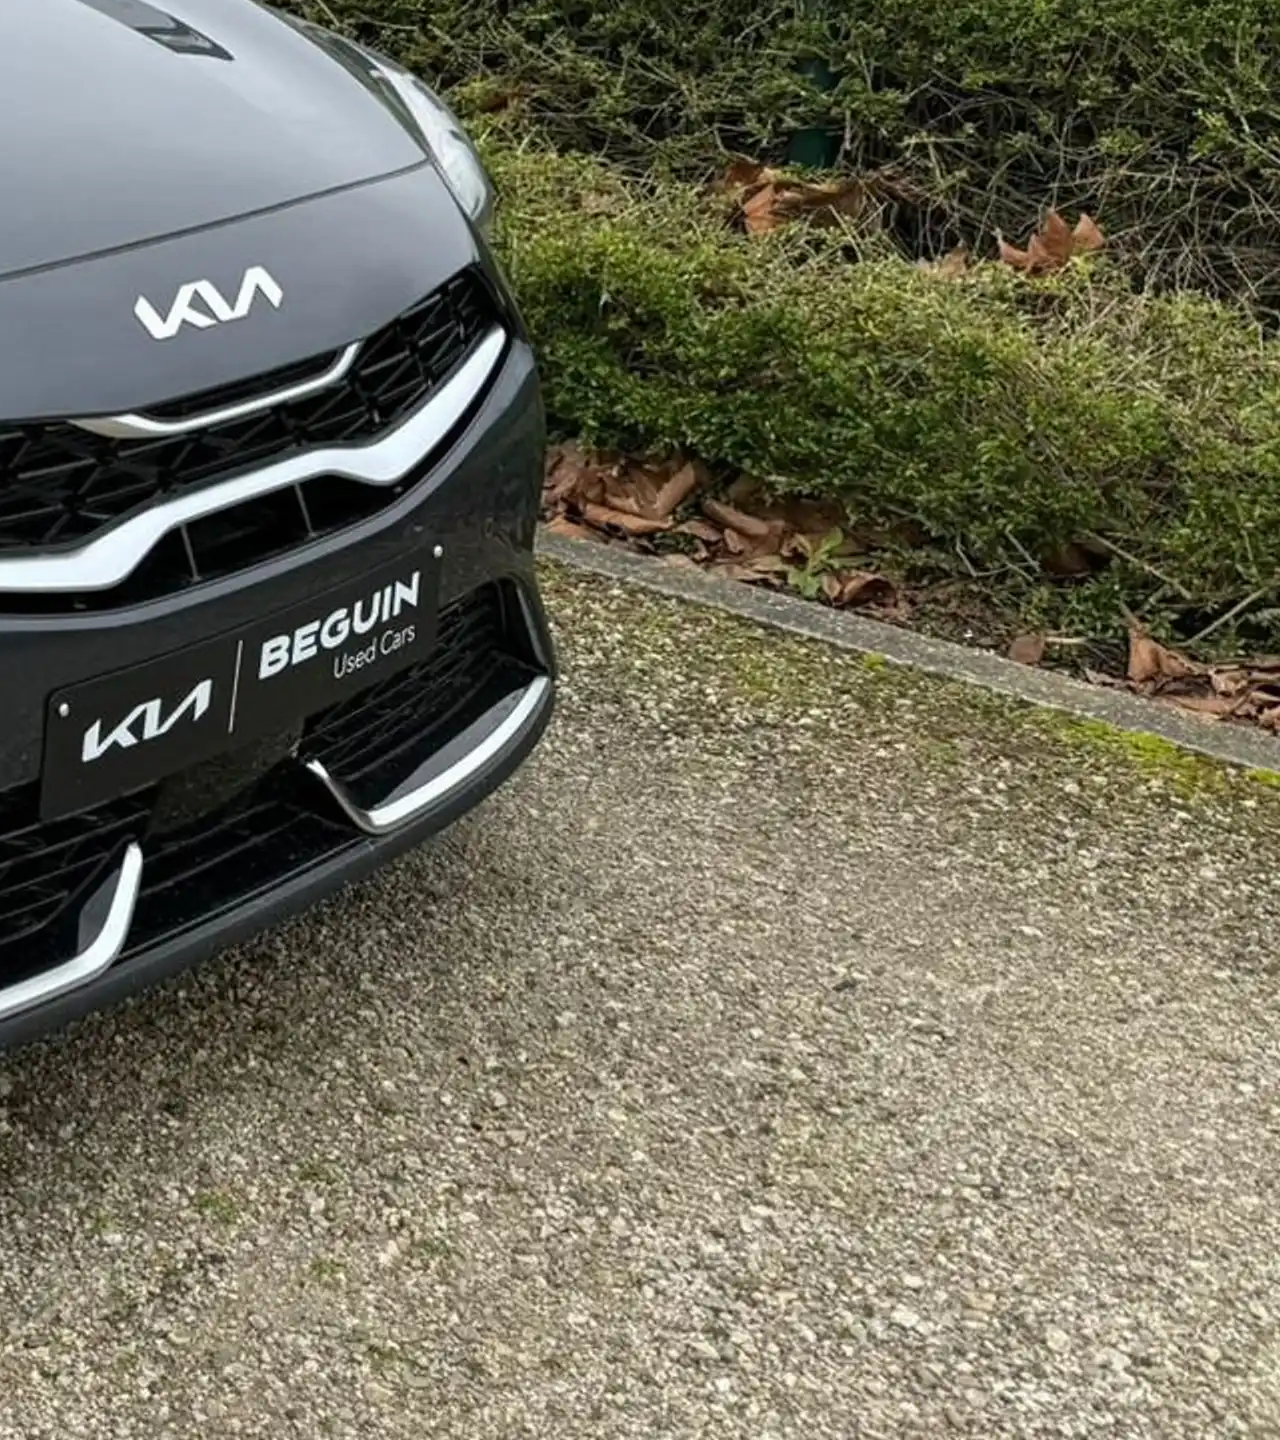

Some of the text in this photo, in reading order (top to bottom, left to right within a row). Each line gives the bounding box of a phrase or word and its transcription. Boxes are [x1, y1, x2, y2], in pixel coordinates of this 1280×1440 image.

[134, 265, 283, 340] KIA
[258, 570, 421, 680] BEGUIN
[334, 624, 415, 679] Used Cars
[82, 678, 213, 763] KIA
